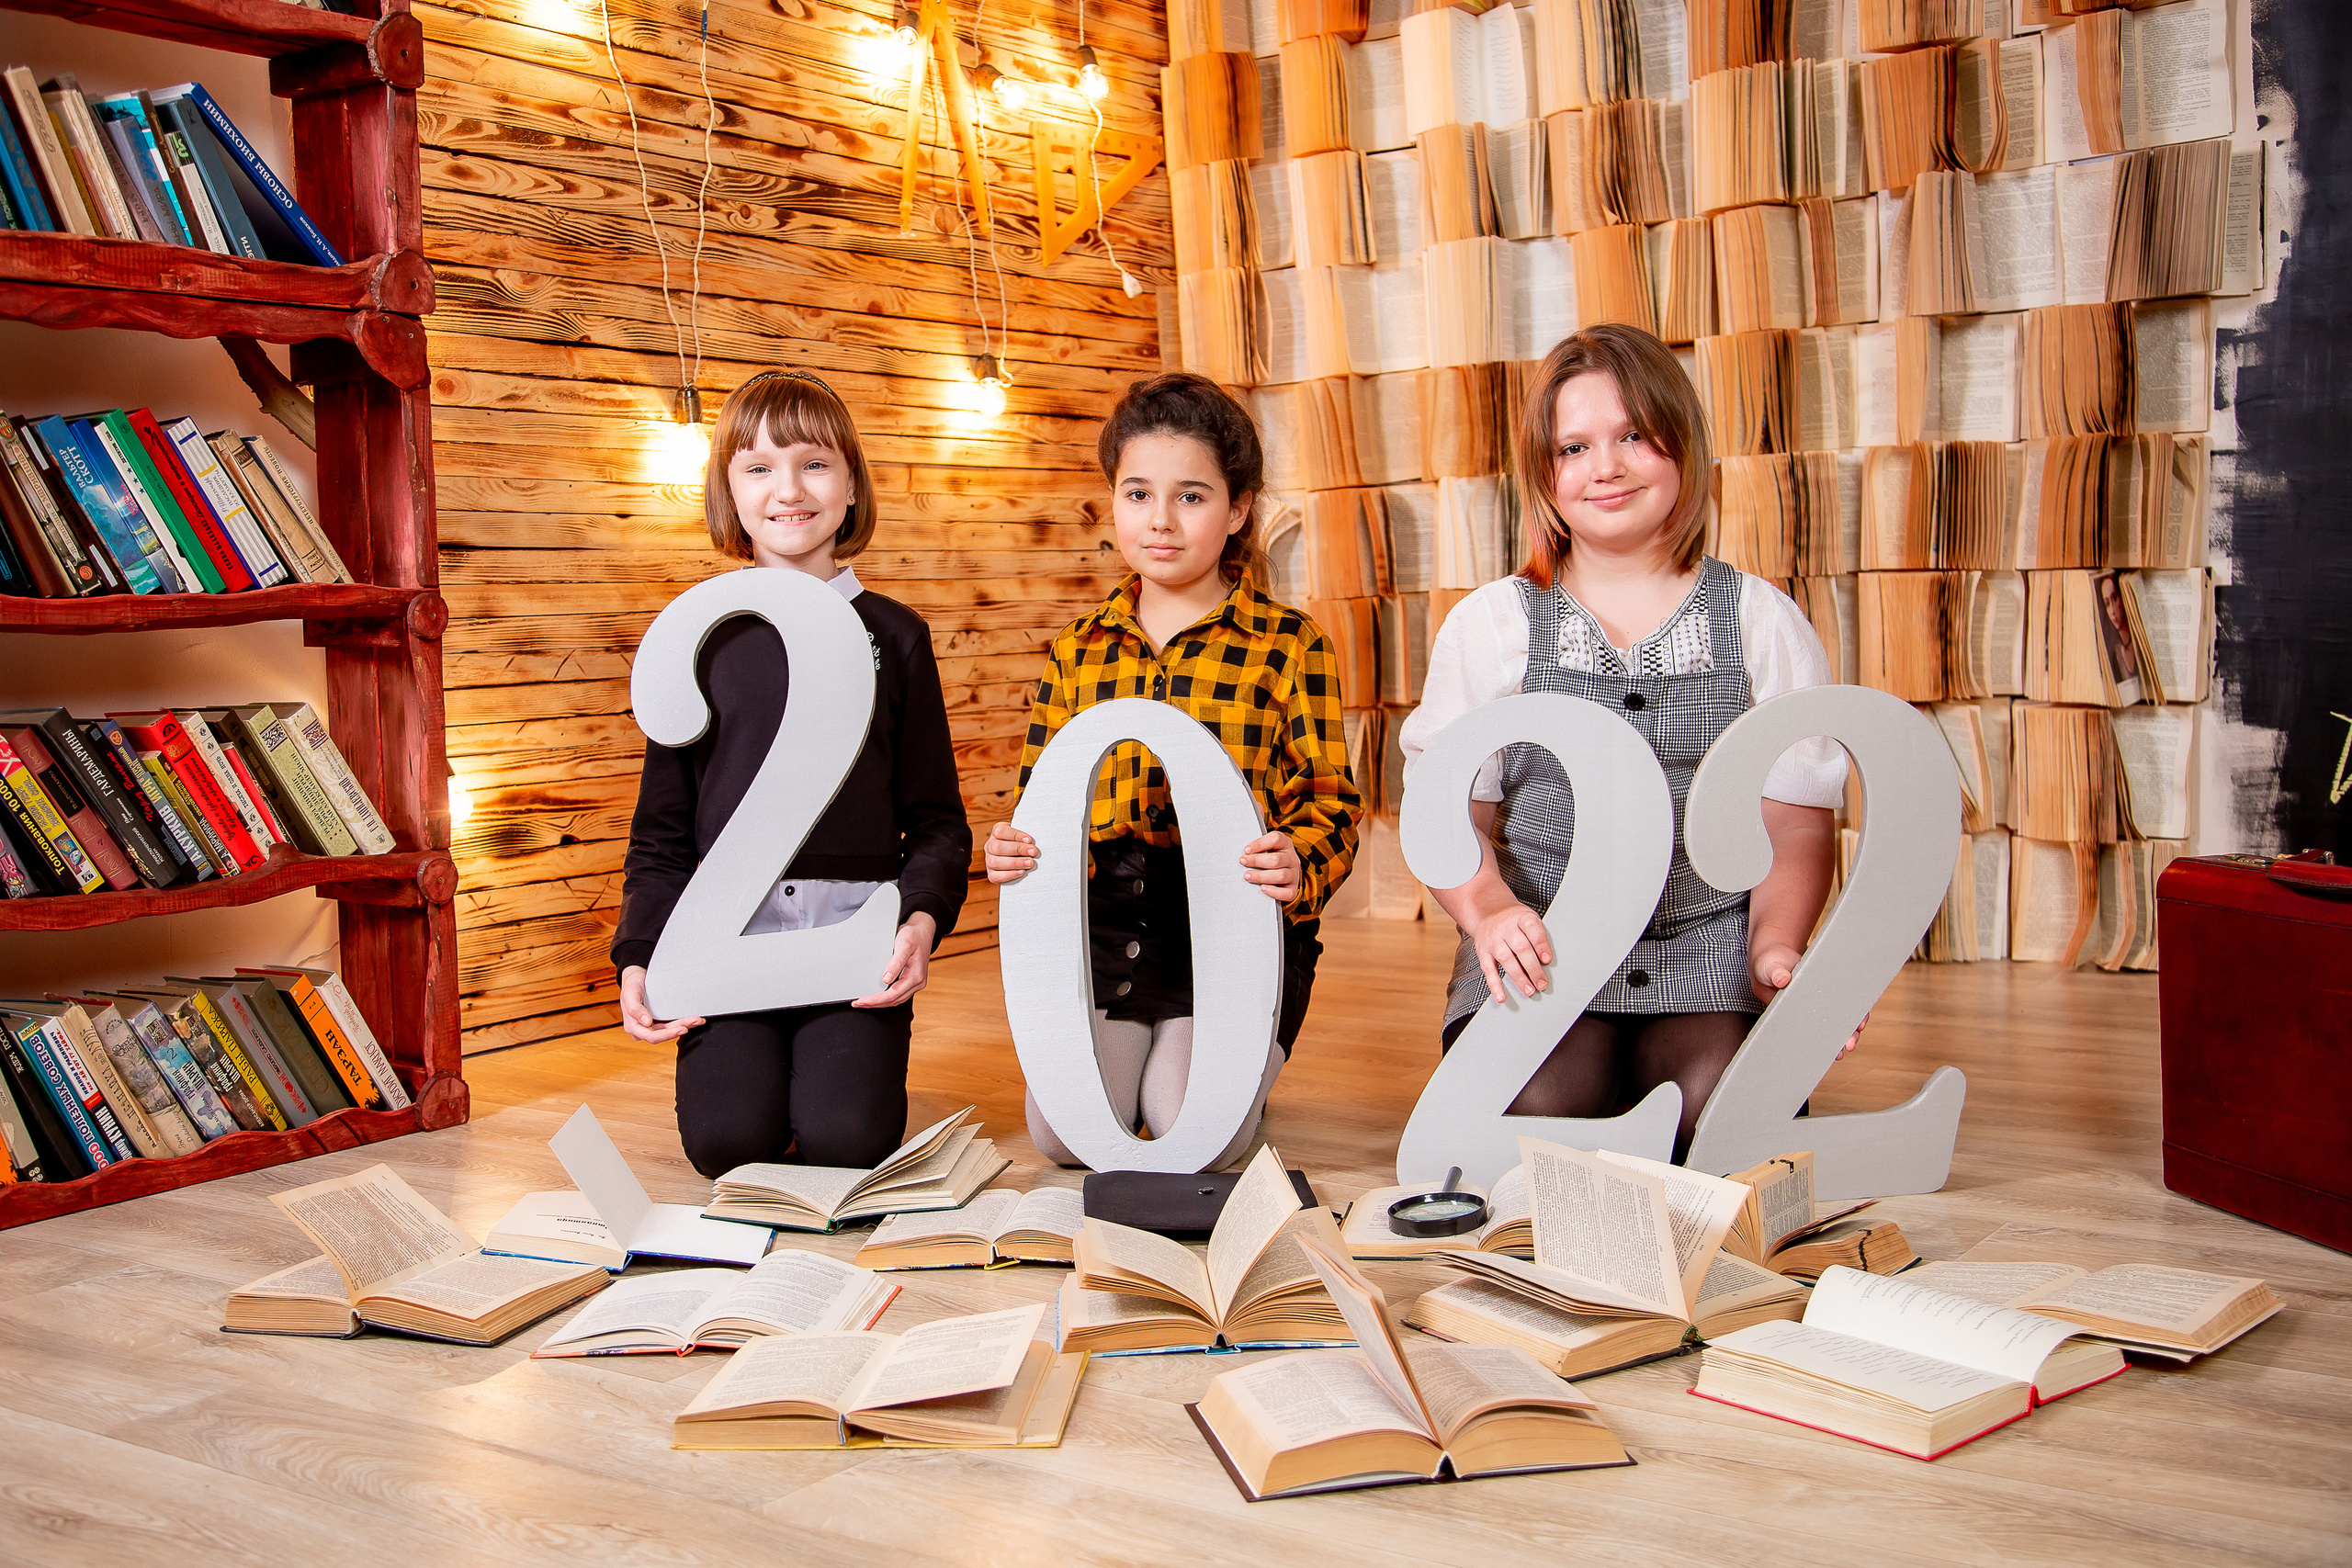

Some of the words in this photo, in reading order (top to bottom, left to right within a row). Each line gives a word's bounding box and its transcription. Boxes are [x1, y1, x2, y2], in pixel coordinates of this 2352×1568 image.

[201, 97, 255, 162] БИОХИМИИ
[152, 186, 171, 217] МИРА
[253, 161, 294, 209] ОСНОВЫ
[165, 220, 183, 245] АНЫ
[56, 446, 87, 488] ВАЛЬТЕР
[65, 443, 96, 484] СКОТТ
[262, 445, 283, 474] ПОВЕСТИ
[281, 474, 314, 525] ПЕТЕРБУРГСКИЕ
[61, 728, 115, 797] ГАРДЕМАРИНЫ
[105, 750, 135, 790] Вильямс
[118, 745, 142, 778] ОТРЕЗАННЫЙ
[131, 757, 146, 775] ПАЛЕЦ
[214, 754, 226, 769] НОЧЬ
[222, 769, 235, 784] ОДНА
[290, 752, 306, 773] МИЛН
[140, 777, 163, 803] ИГРА
[233, 787, 250, 808] ТЫСЯЧА
[291, 776, 314, 807] КИПЛИНГ
[295, 772, 320, 805] ЛИНДГРЕН
[302, 773, 329, 808] АЛЕКСАНДР
[132, 790, 157, 821] Чарлз
[311, 807, 331, 834] РЕДЬЯРД
[316, 806, 335, 829] АСТРИД
[325, 808, 340, 826] АЛАН
[17, 811, 67, 874] Толкования
[197, 816, 224, 852] МАРИНИНА
[152, 847, 164, 863] РОМАН
[630, 568, 902, 1021] 2
[998, 698, 1286, 1177] 0
[1397, 692, 1683, 1188] 2
[1686, 685, 1967, 1200] 2
[204, 1004, 238, 1053] ПАРИЖА
[28, 1033, 62, 1085] СОВЕТОВ
[49, 1031, 73, 1066] РАБИНОВИЧ
[323, 1028, 364, 1086] ТАРЗАН
[361, 1040, 390, 1077] МАКНОТ
[73, 1071, 89, 1095] ИВАНОВ
[170, 1067, 197, 1100] графиня
[181, 1059, 206, 1090] ШАРНИ
[209, 1060, 234, 1092] графиня
[217, 1053, 242, 1083] ШАРНИ
[232, 1051, 257, 1084] РАБЫ
[102, 1064, 136, 1119] НЕЗНАЙКА
[236, 1088, 249, 1103] ДЮМА
[380, 1073, 409, 1109] ДЖУДИТ
[54, 1081, 95, 1144] ПОЛЕЗНЫХ
[93, 1104, 123, 1143] КУНИН
[245, 1101, 266, 1127] АЛЕКСАНДР
